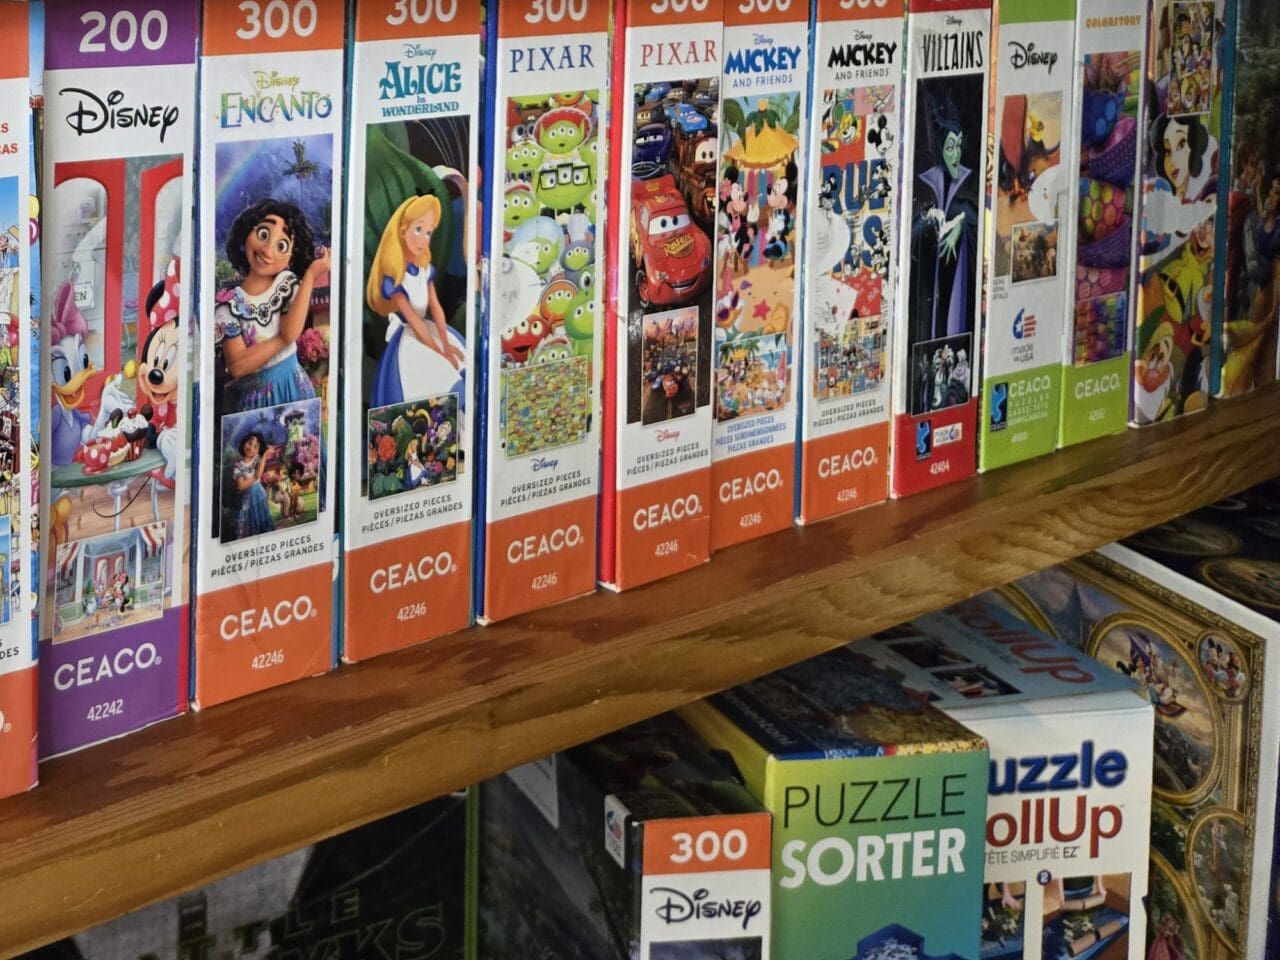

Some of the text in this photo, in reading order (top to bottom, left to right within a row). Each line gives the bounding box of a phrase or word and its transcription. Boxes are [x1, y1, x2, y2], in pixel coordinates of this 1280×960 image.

[79, 9, 169, 53] 200
[236, 0, 317, 40] 300
[403, 43, 437, 60] Disney
[509, 44, 595, 73] PIXAR
[640, 39, 717, 67] PIXAR
[724, 45, 801, 75] MICKEY
[828, 41, 897, 68] MICKEY
[923, 30, 983, 73] VILLAINS
[1008, 41, 1058, 75] Disney
[254, 70, 300, 91] Disney
[379, 61, 462, 100] ALICE
[733, 74, 793, 89] AND FRIENDS
[835, 68, 890, 81] AND FRIENDS
[59, 87, 179, 143] Disney
[220, 91, 332, 128] ENCANTO
[381, 102, 459, 117] WONDERLAND
[1009, 375, 1051, 398] CEACO
[1075, 373, 1120, 400] CEACO
[821, 403, 854, 417] OVERSIZED
[654, 428, 680, 442] Disney
[531, 457, 558, 472] Disney
[636, 441, 700, 464] OVERSIZED PIECES
[654, 456, 678, 469] PIEZAS
[679, 449, 709, 462] GRANDES
[818, 446, 876, 478] CEACO
[511, 470, 581, 494] OVERSIZED PIECES
[531, 487, 557, 500] PIEZAS
[559, 477, 591, 491] GRANDES
[719, 469, 781, 503] CEACO
[361, 502, 463, 533] PIÈCES PIEZAS GRANDES
[373, 494, 452, 520] OVERSIZED PIECES
[633, 494, 699, 531] CEACO
[225, 534, 312, 563] OVERSIZED PIECES
[507, 524, 581, 564] CEACO
[211, 542, 325, 578] PIÈCES PIEZAS GRANDES
[370, 552, 452, 593] CEACO
[531, 572, 558, 590] 42246
[220, 595, 313, 640] CEACO
[397, 601, 427, 621] 42246
[54, 642, 157, 691] CEACO
[251, 649, 285, 670] 42246
[86, 698, 124, 721] 42242
[988, 739, 1128, 795] uzzle
[783, 773, 968, 830] PUZZLE
[986, 795, 1123, 859] ollUp
[670, 828, 748, 864] 300
[779, 827, 967, 889] SORTER
[1063, 846, 1078, 859] EZ
[650, 886, 762, 931] Disney
